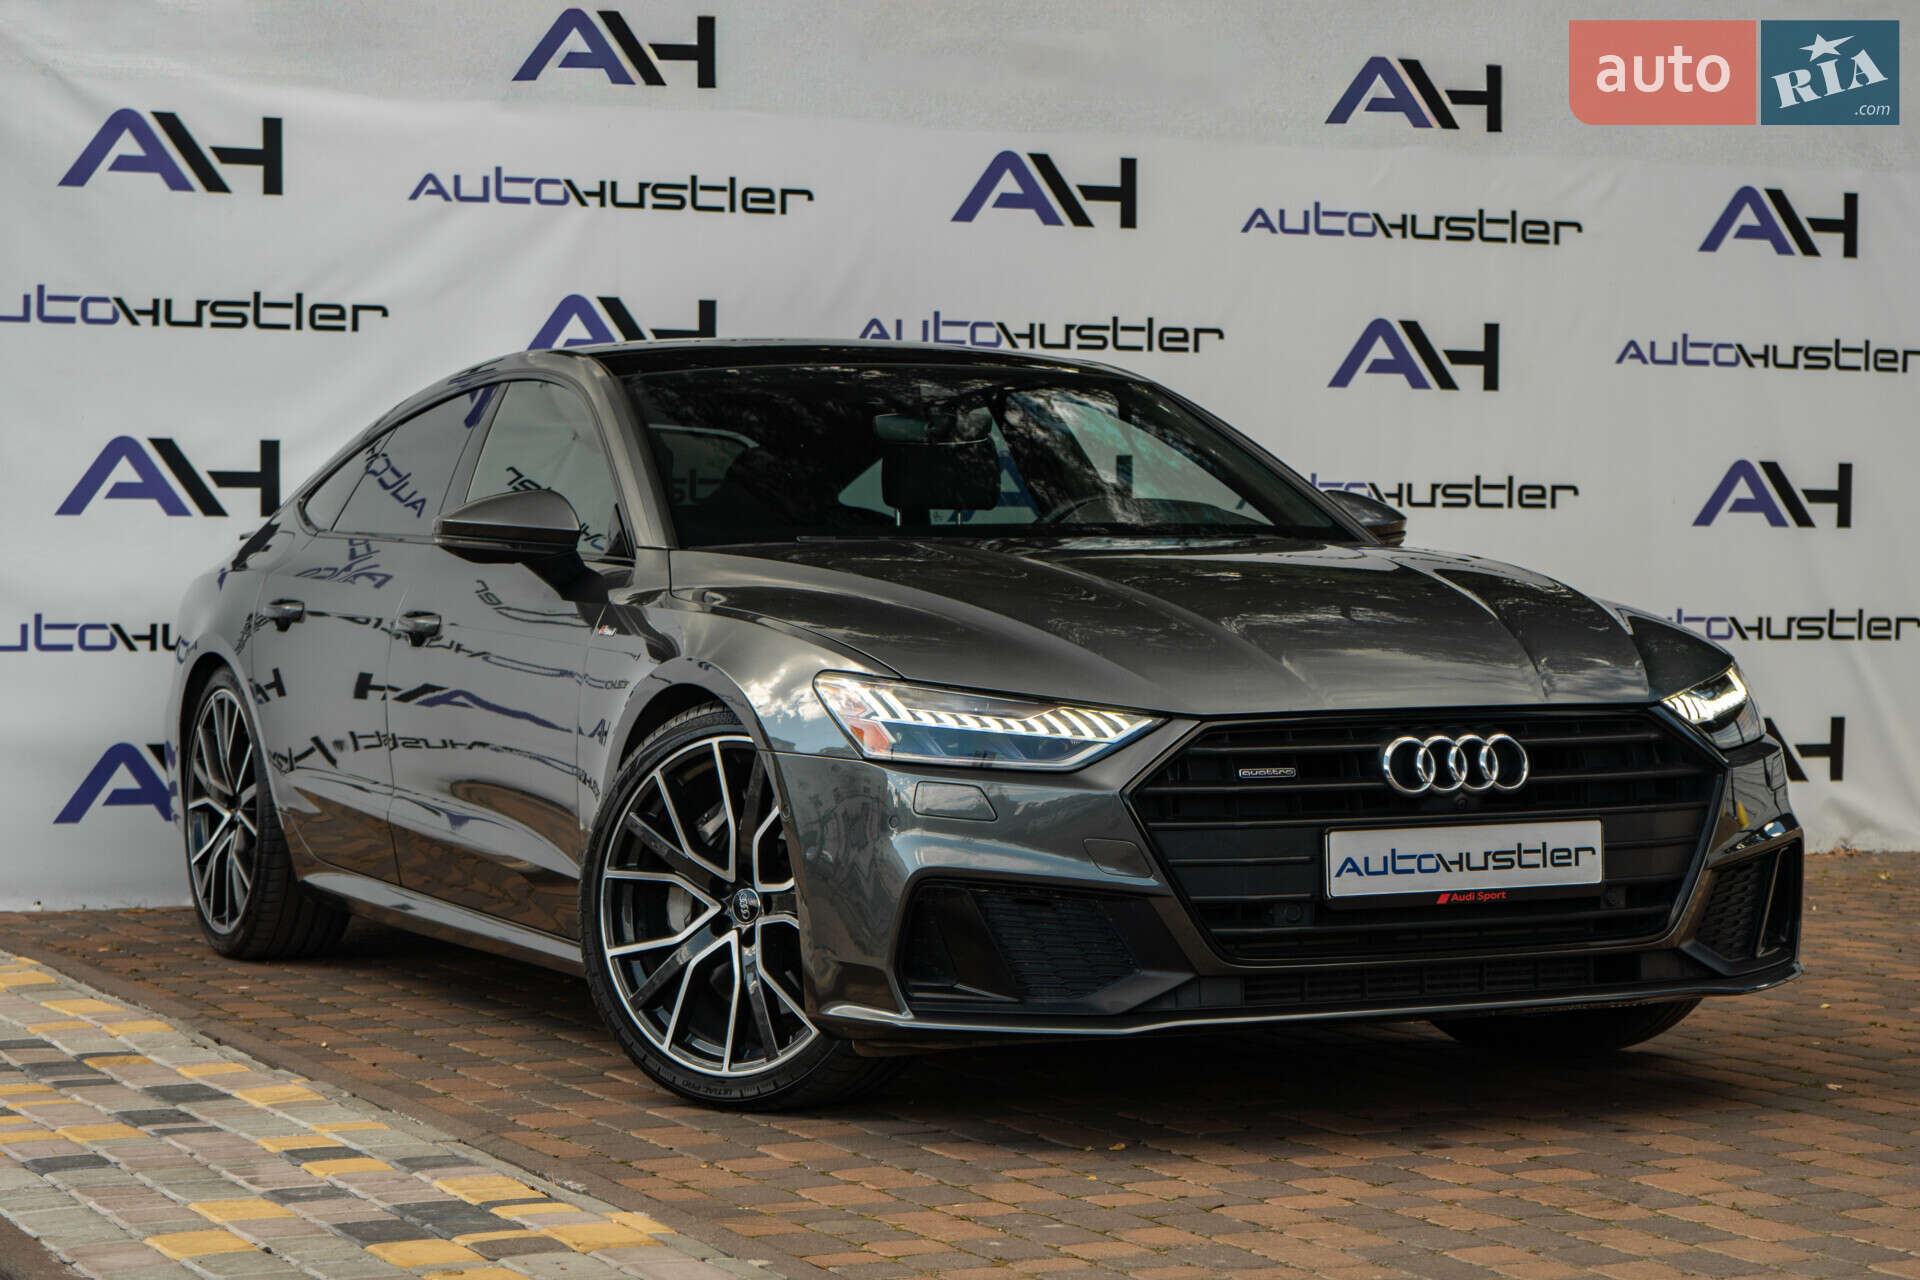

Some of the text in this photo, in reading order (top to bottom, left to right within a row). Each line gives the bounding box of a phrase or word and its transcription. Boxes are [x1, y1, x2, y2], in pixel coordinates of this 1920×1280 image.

[511, 7, 717, 89] AH
[1324, 56, 1503, 133] AH
[57, 108, 284, 196] AH
[951, 150, 1138, 229] AH
[1698, 185, 1859, 259] AH
[1327, 317, 1500, 392] AH
[54, 435, 281, 517] AH
[1692, 459, 1853, 529] AH
[52, 742, 173, 825] A
[1241, 768, 1294, 777] quattro
[1451, 890, 1507, 902] Audi Sport
